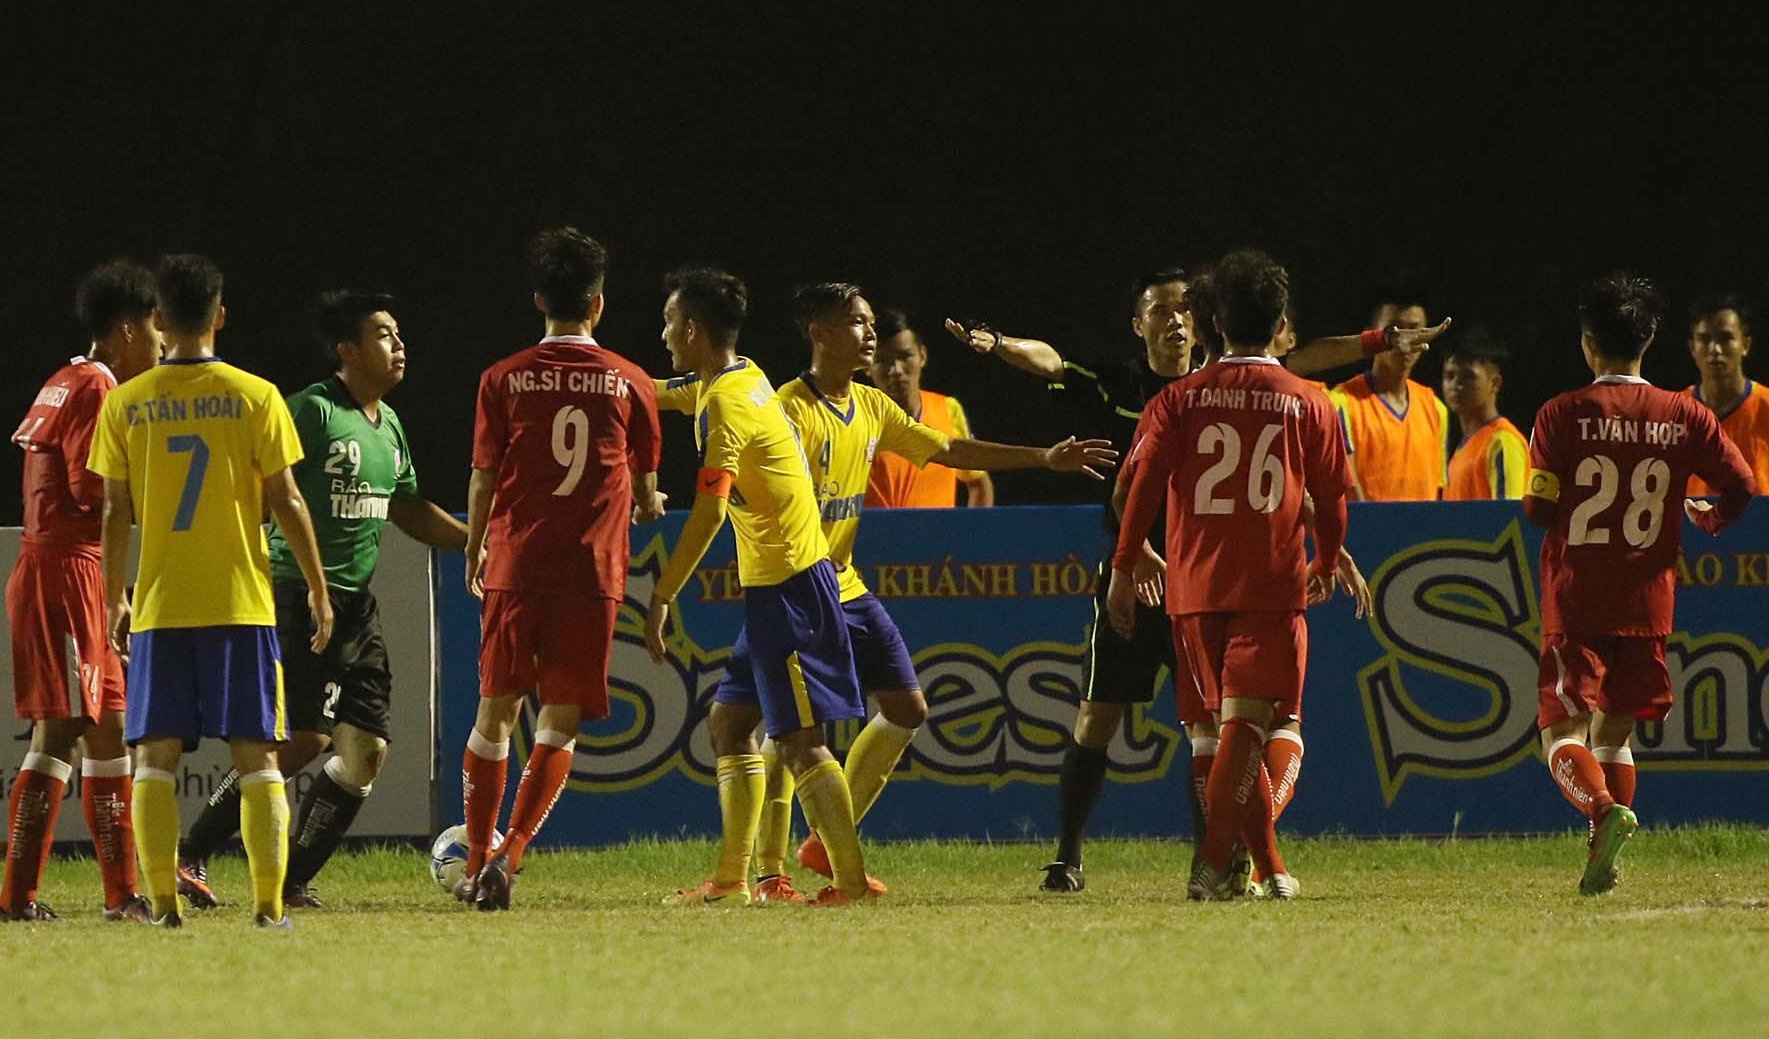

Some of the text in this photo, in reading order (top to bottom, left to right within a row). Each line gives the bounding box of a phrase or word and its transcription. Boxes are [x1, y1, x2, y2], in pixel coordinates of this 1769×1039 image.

[508, 366, 631, 399] NG.SĨ CHIẾN
[1186, 388, 1247, 409] T.DANH
[127, 390, 187, 426] C.TẤN
[551, 405, 589, 496] 9
[1577, 415, 1687, 450] T.VĂN HỢP
[324, 440, 361, 476] 29
[819, 440, 831, 475] 4
[1194, 422, 1286, 516] 26
[167, 434, 210, 532] 7
[1531, 474, 1548, 495] C
[1567, 454, 1671, 549] 28
[876, 555, 1020, 598] KHÁNH
